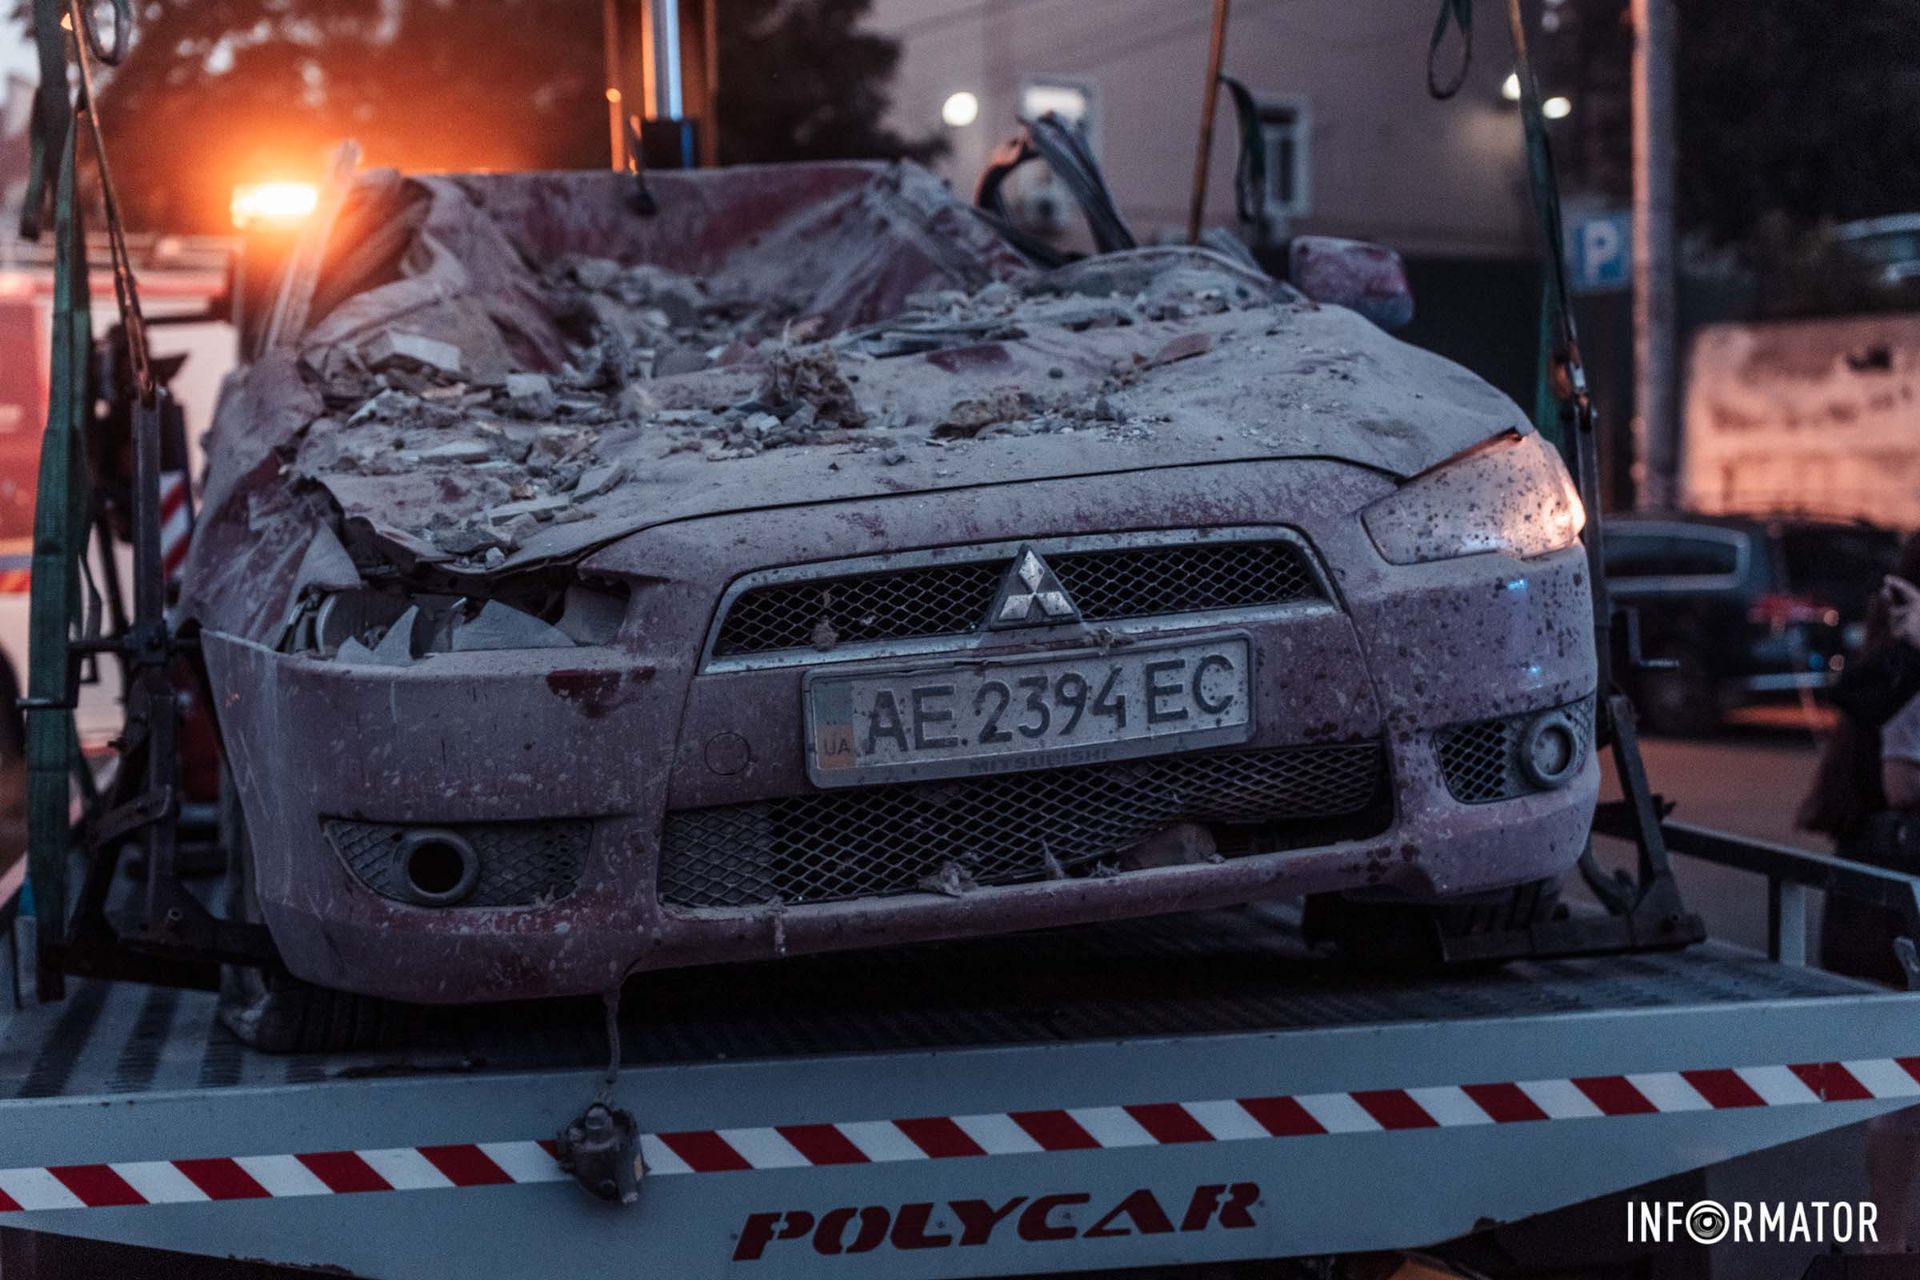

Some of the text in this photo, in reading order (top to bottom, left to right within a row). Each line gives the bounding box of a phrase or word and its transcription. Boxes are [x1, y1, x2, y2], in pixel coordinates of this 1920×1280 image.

[1584, 221, 1618, 282] P
[865, 654, 1235, 755] AE 2394 EC
[823, 738, 851, 757] UA
[732, 1182, 1261, 1261] POLYCAR
